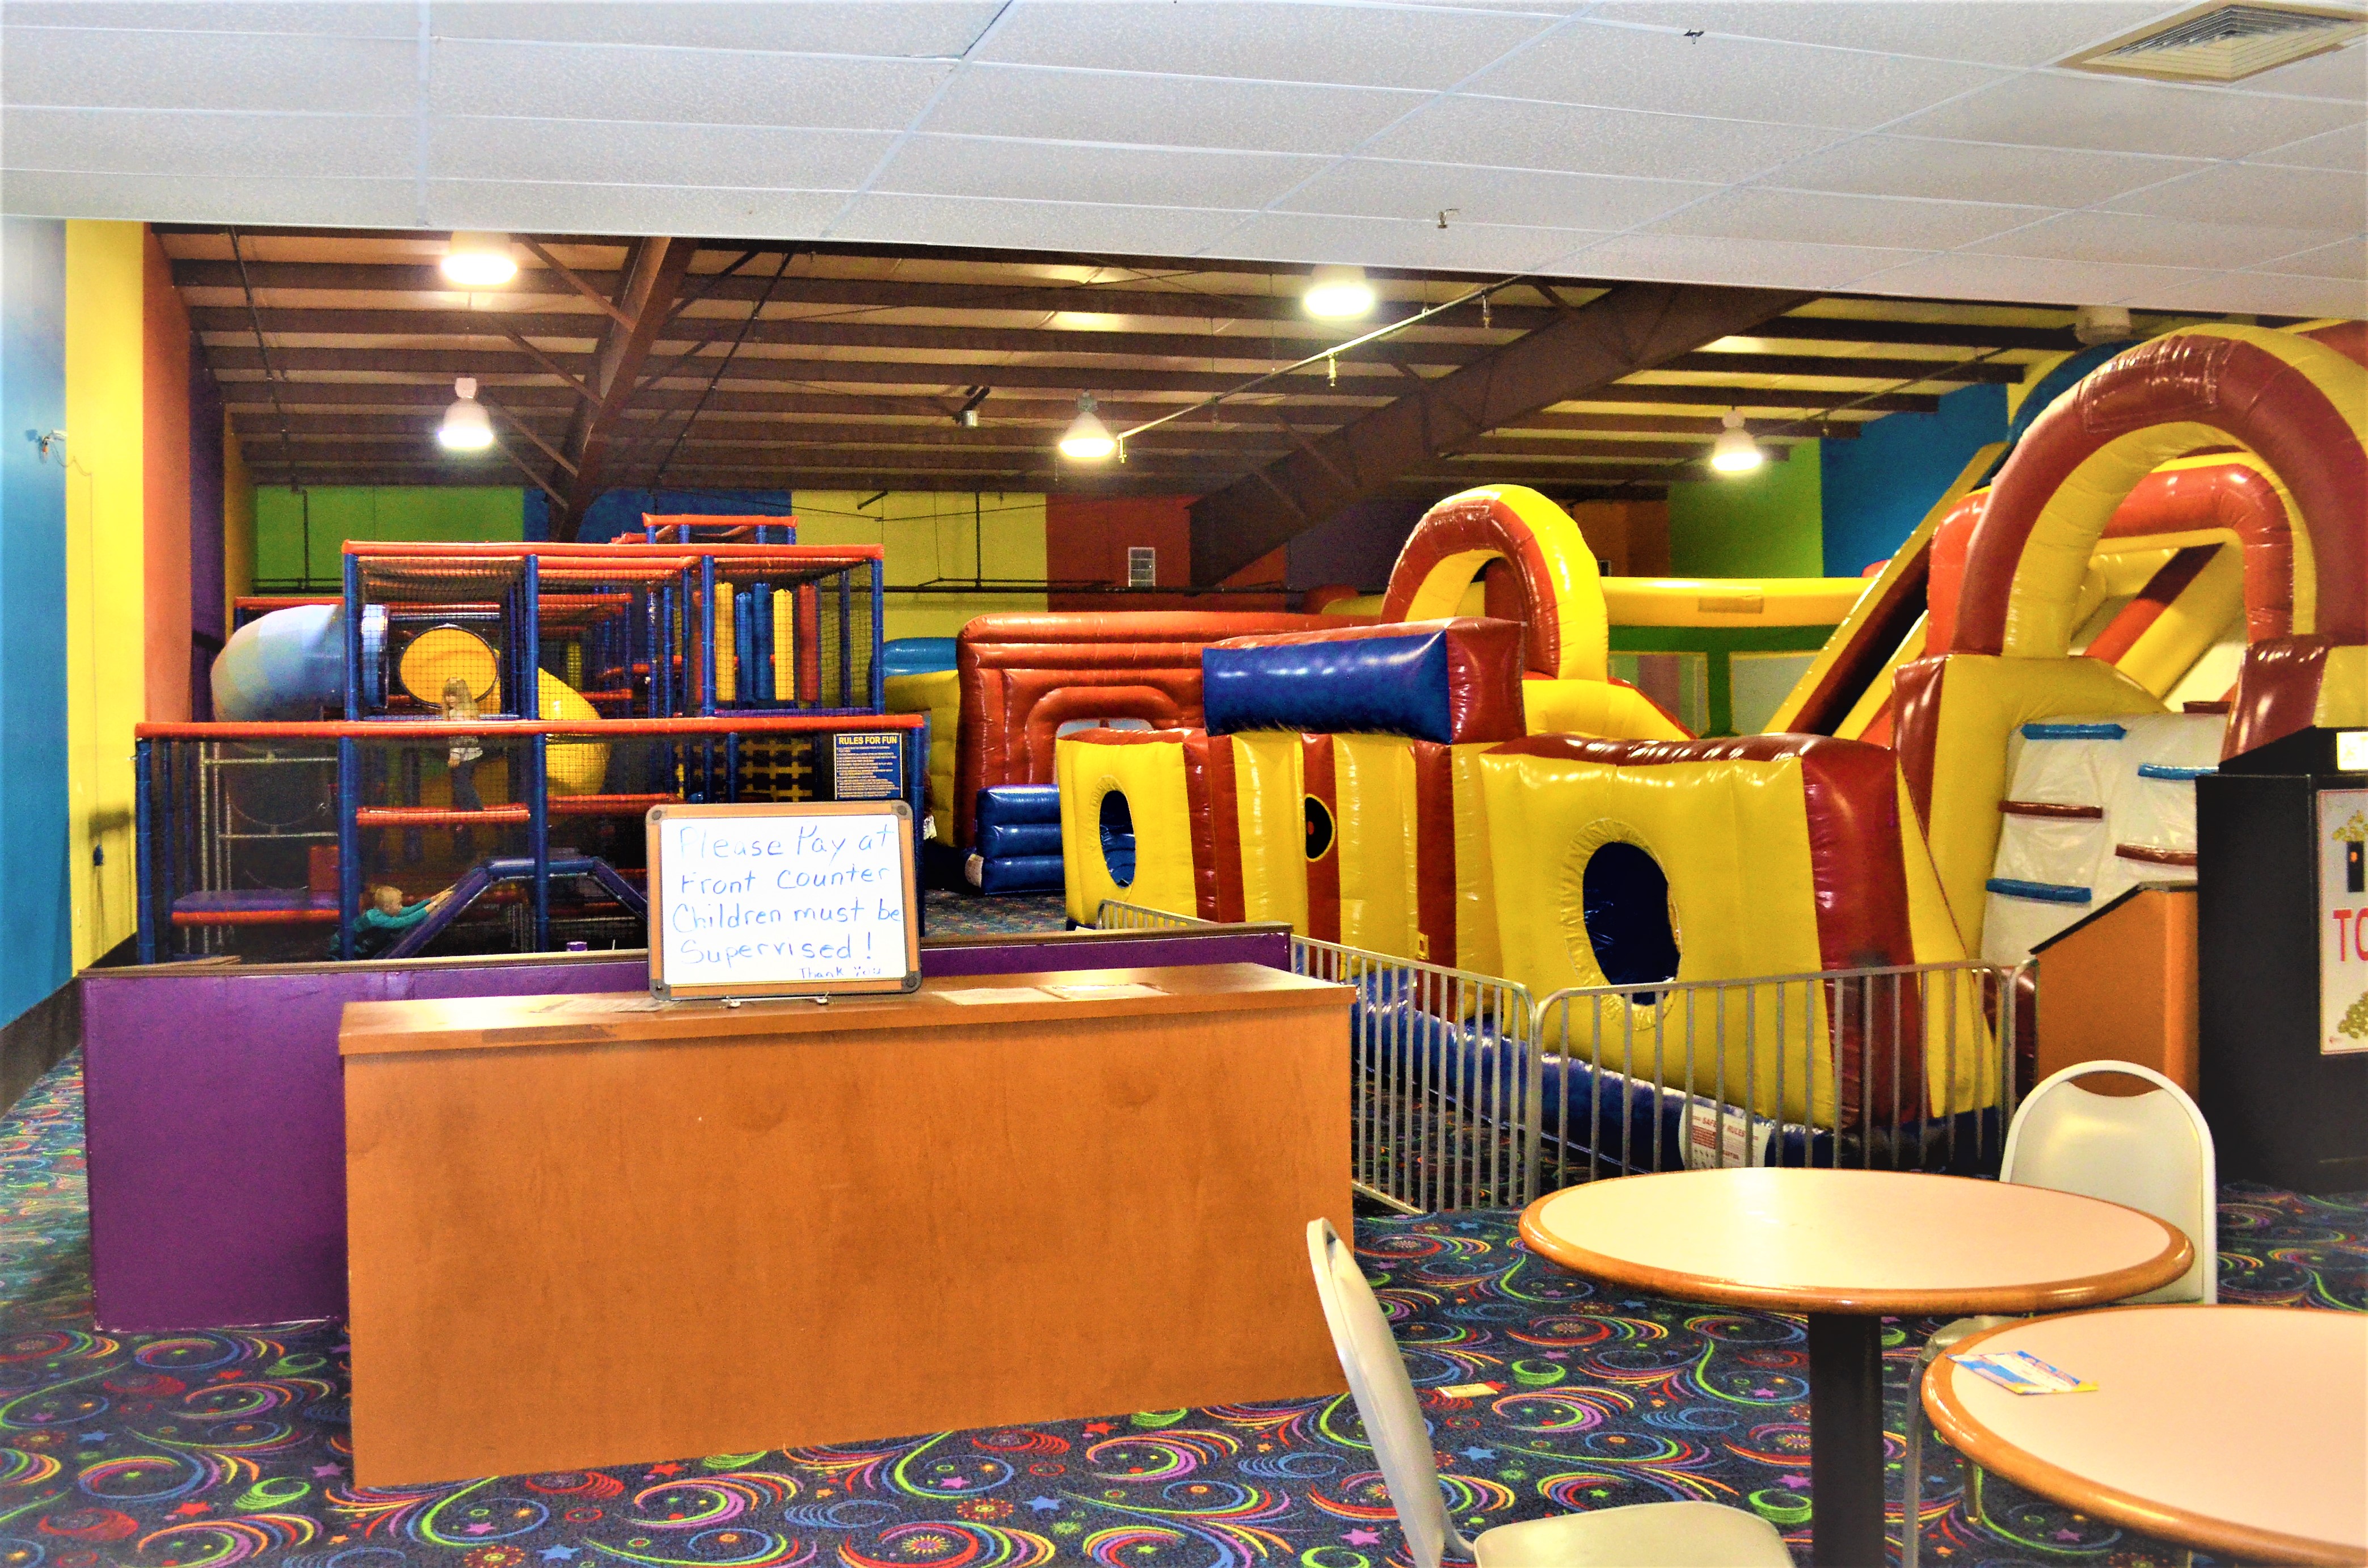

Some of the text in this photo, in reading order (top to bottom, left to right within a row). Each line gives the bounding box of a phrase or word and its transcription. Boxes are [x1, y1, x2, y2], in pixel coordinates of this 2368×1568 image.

[680, 824, 894, 865] Please Pay at
[682, 871, 756, 894] Front
[673, 897, 900, 932] Children must be
[799, 966, 844, 979] Thank
